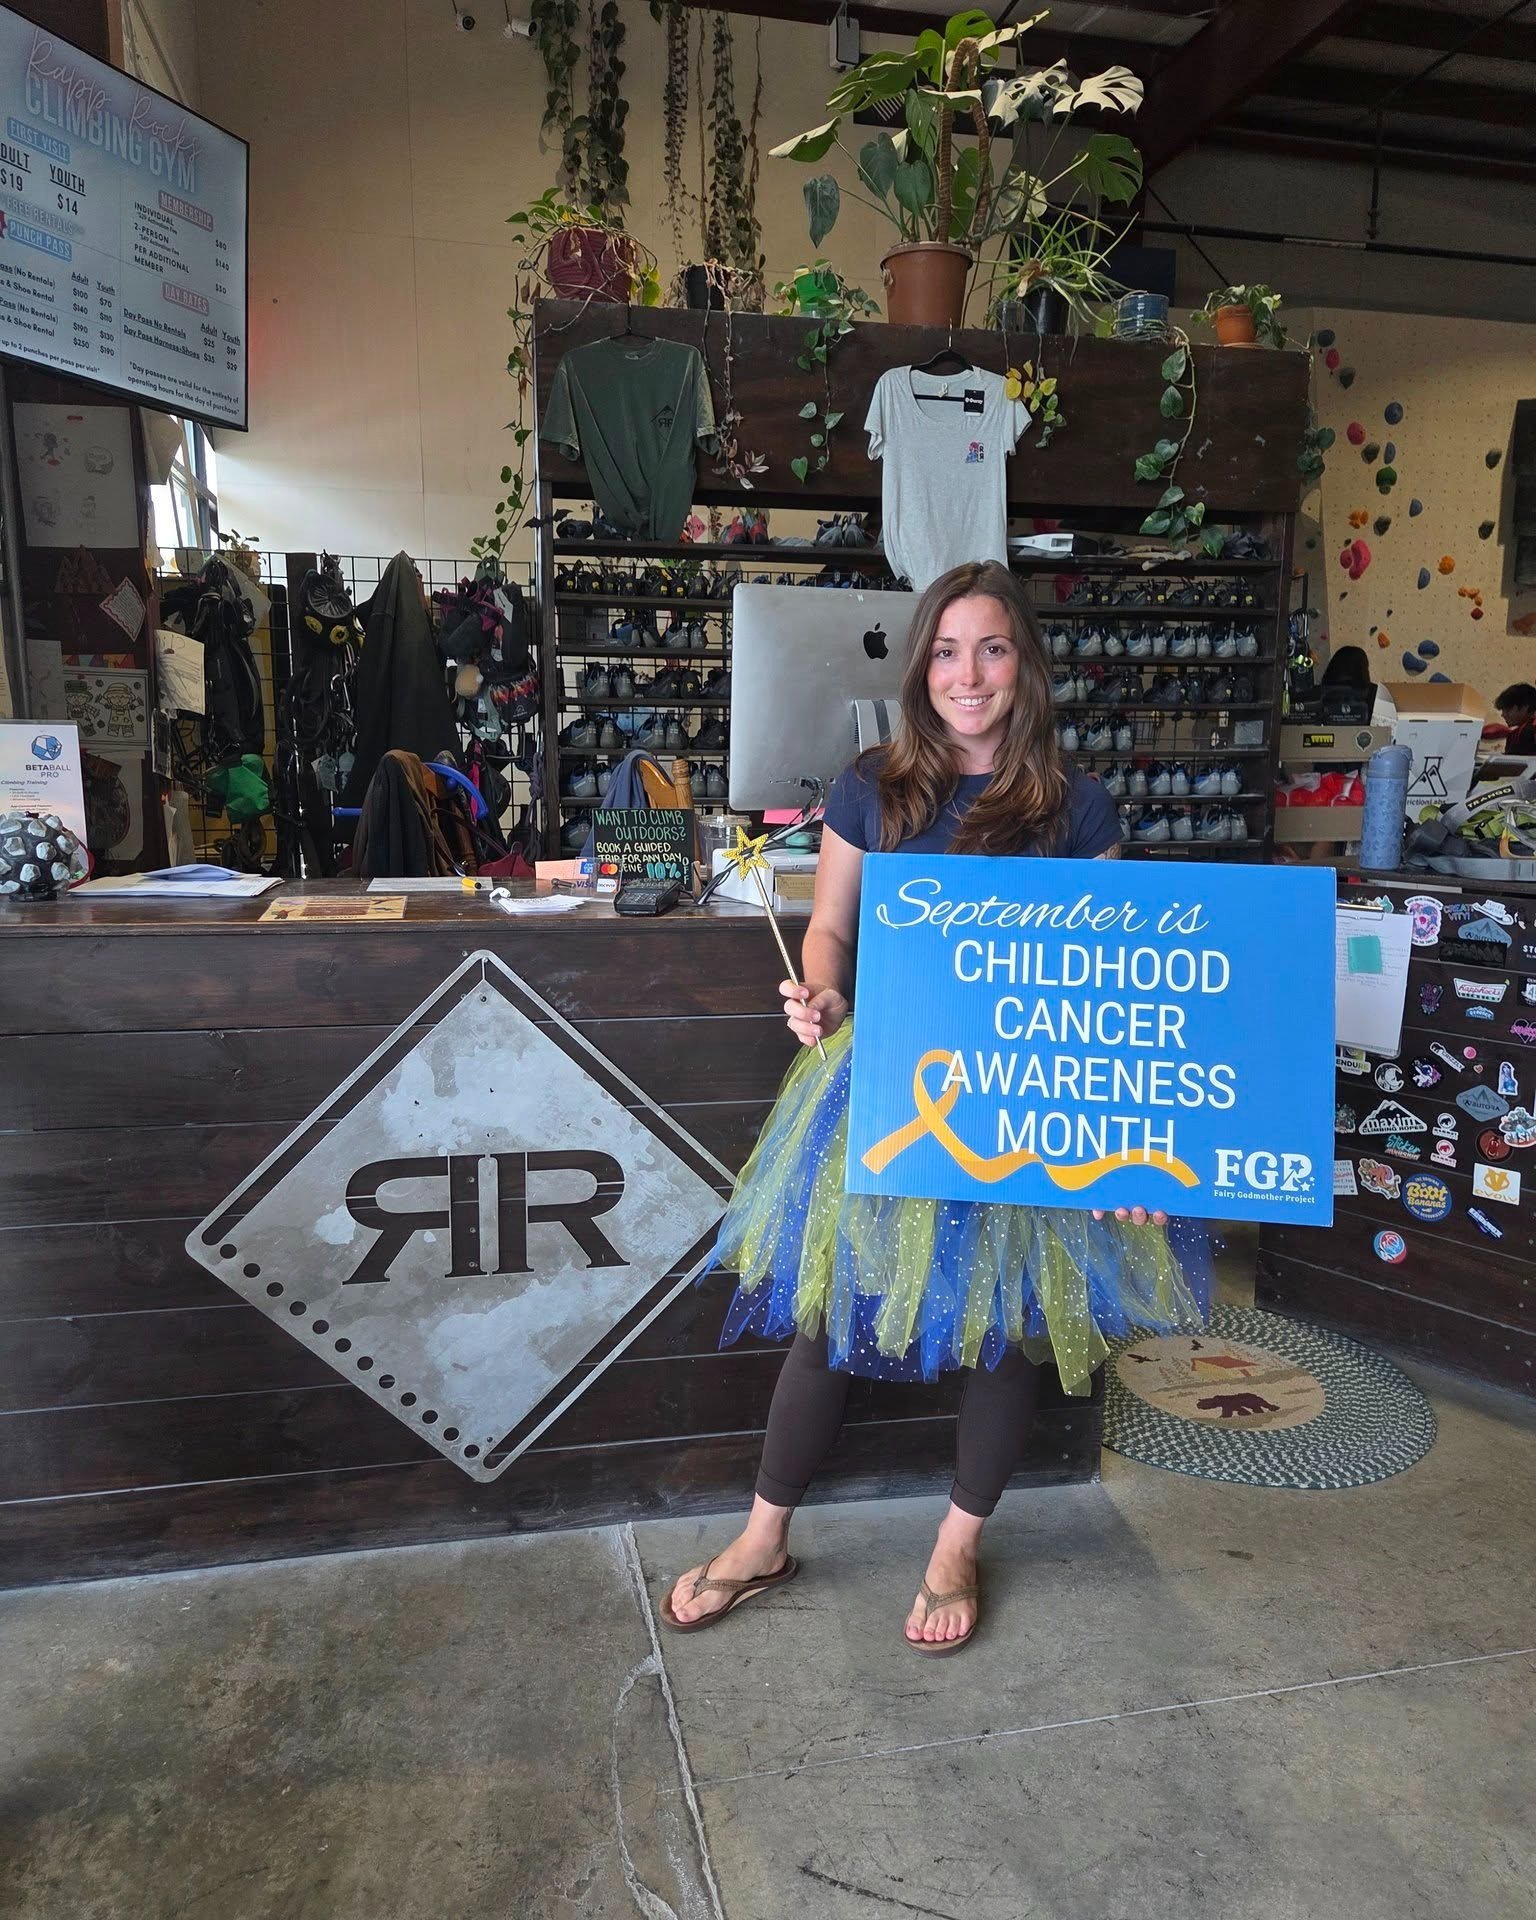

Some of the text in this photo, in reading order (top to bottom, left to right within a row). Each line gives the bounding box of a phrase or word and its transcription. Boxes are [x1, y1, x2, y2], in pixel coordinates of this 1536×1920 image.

[10, 120, 68, 158] FIRST VISIT
[26, 75, 195, 192] CLIMBING GYM
[0, 143, 85, 193] DULT YOUTH
[0, 168, 78, 215] $19 $14
[134, 202, 174, 226] INDIVIDUAL
[161, 192, 212, 227] MEMBERSHIP
[10, 220, 70, 256] PUNCH PASS
[134, 222, 169, 244] 2-PERSON
[134, 244, 190, 273] PER ADDITIONAL
[134, 255, 164, 273] MEMBER
[14, 265, 26, 277] (No
[27, 271, 56, 289] Rentals)
[72, 272, 116, 296] Adult Youth
[13, 282, 31, 296] Shoe
[33, 289, 54, 303] Rental
[72, 287, 112, 309] $100 $70
[165, 284, 208, 312] DAY RATES
[17, 303, 29, 314] (No
[31, 307, 58, 324] Rentals)
[72, 302, 113, 323] $140 $110
[13, 317, 31, 330] Shoe
[33, 324, 55, 337] Rental
[123, 308, 186, 339] Day Pass No Rentals
[123, 325, 137, 338] Day
[138, 330, 153, 343] Pass
[200, 322, 240, 346] Adult Youth
[73, 337, 90, 349] $250
[99, 330, 114, 342] $130
[203, 337, 237, 356] $25 $19
[23, 346, 49, 359] punches
[49, 353, 60, 361] per
[60, 358, 75, 367] pass
[226, 361, 238, 372] $29
[145, 367, 167, 380] passes
[167, 376, 178, 385] are
[178, 379, 193, 390] valid
[127, 375, 158, 392] operating
[158, 384, 175, 396] hours
[194, 396, 205, 407] day
[25, 764, 71, 772] BETABALL
[40, 771, 59, 779] PRO
[1467, 786, 1512, 809] TRANGO
[595, 809, 684, 826] WANT TO CLIMB
[615, 826, 686, 841] OUTDOORS?
[596, 841, 671, 853] BOOK A GUIDED
[597, 852, 682, 864] TRIP FOR ANY DAY
[646, 861, 682, 880] 10%
[576, 880, 595, 889] VISA
[876, 878, 1209, 938] September is
[954, 939, 1231, 994] CHILDHOOD
[994, 996, 1187, 1049] CANCER
[1336, 1059, 1369, 1071] ENDURE
[941, 1049, 1237, 1110] AWARENESS
[1362, 1124, 1425, 1133] CLIMBING ROPES
[1366, 1113, 1415, 1128] maxim
[997, 1108, 1175, 1164] MONTH
[1214, 1149, 1313, 1192] FGP
[1213, 1189, 1315, 1204] Fairy Godmother Project
[1407, 1196, 1446, 1209] Bananas
